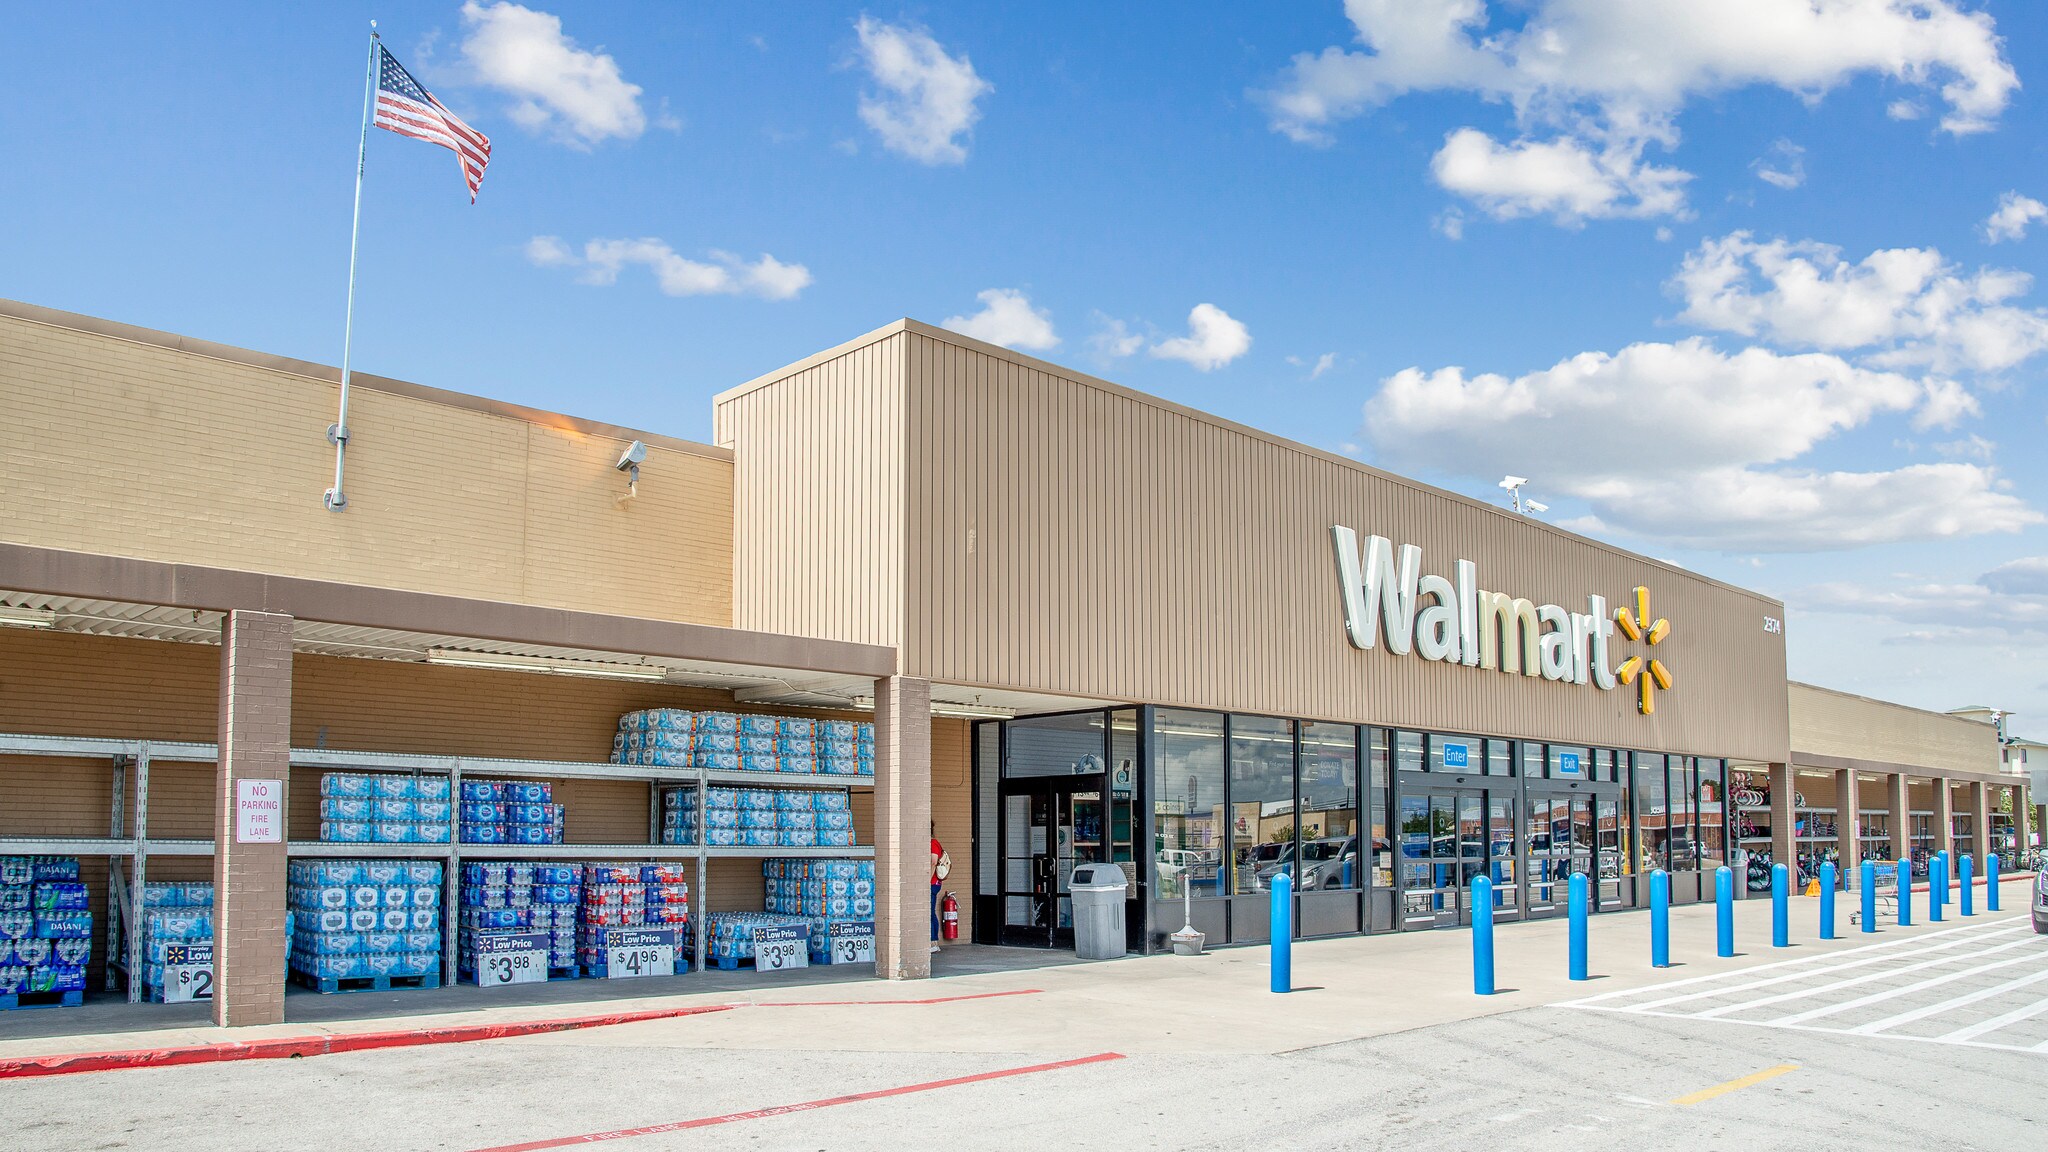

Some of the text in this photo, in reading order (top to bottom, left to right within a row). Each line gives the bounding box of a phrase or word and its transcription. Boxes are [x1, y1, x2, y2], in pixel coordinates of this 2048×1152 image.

[1329, 525, 1616, 691] Walmart
[1763, 616, 1781, 635] 2374
[1446, 749, 1466, 763] Enter
[1320, 761, 1340, 769] DONATE
[1564, 757, 1576, 770] Exit
[252, 786, 268, 796] NO
[241, 800, 278, 810] PARKING
[251, 814, 268, 823] FIRE
[250, 828, 269, 836] LANE
[40, 865, 69, 874] DASANI
[51, 921, 81, 931] DASANI
[840, 925, 871, 934] Low Price
[622, 934, 661, 944] Low Price
[766, 929, 797, 939] Low Price
[493, 939, 532, 949] Low Price
[188, 951, 213, 960] Low
